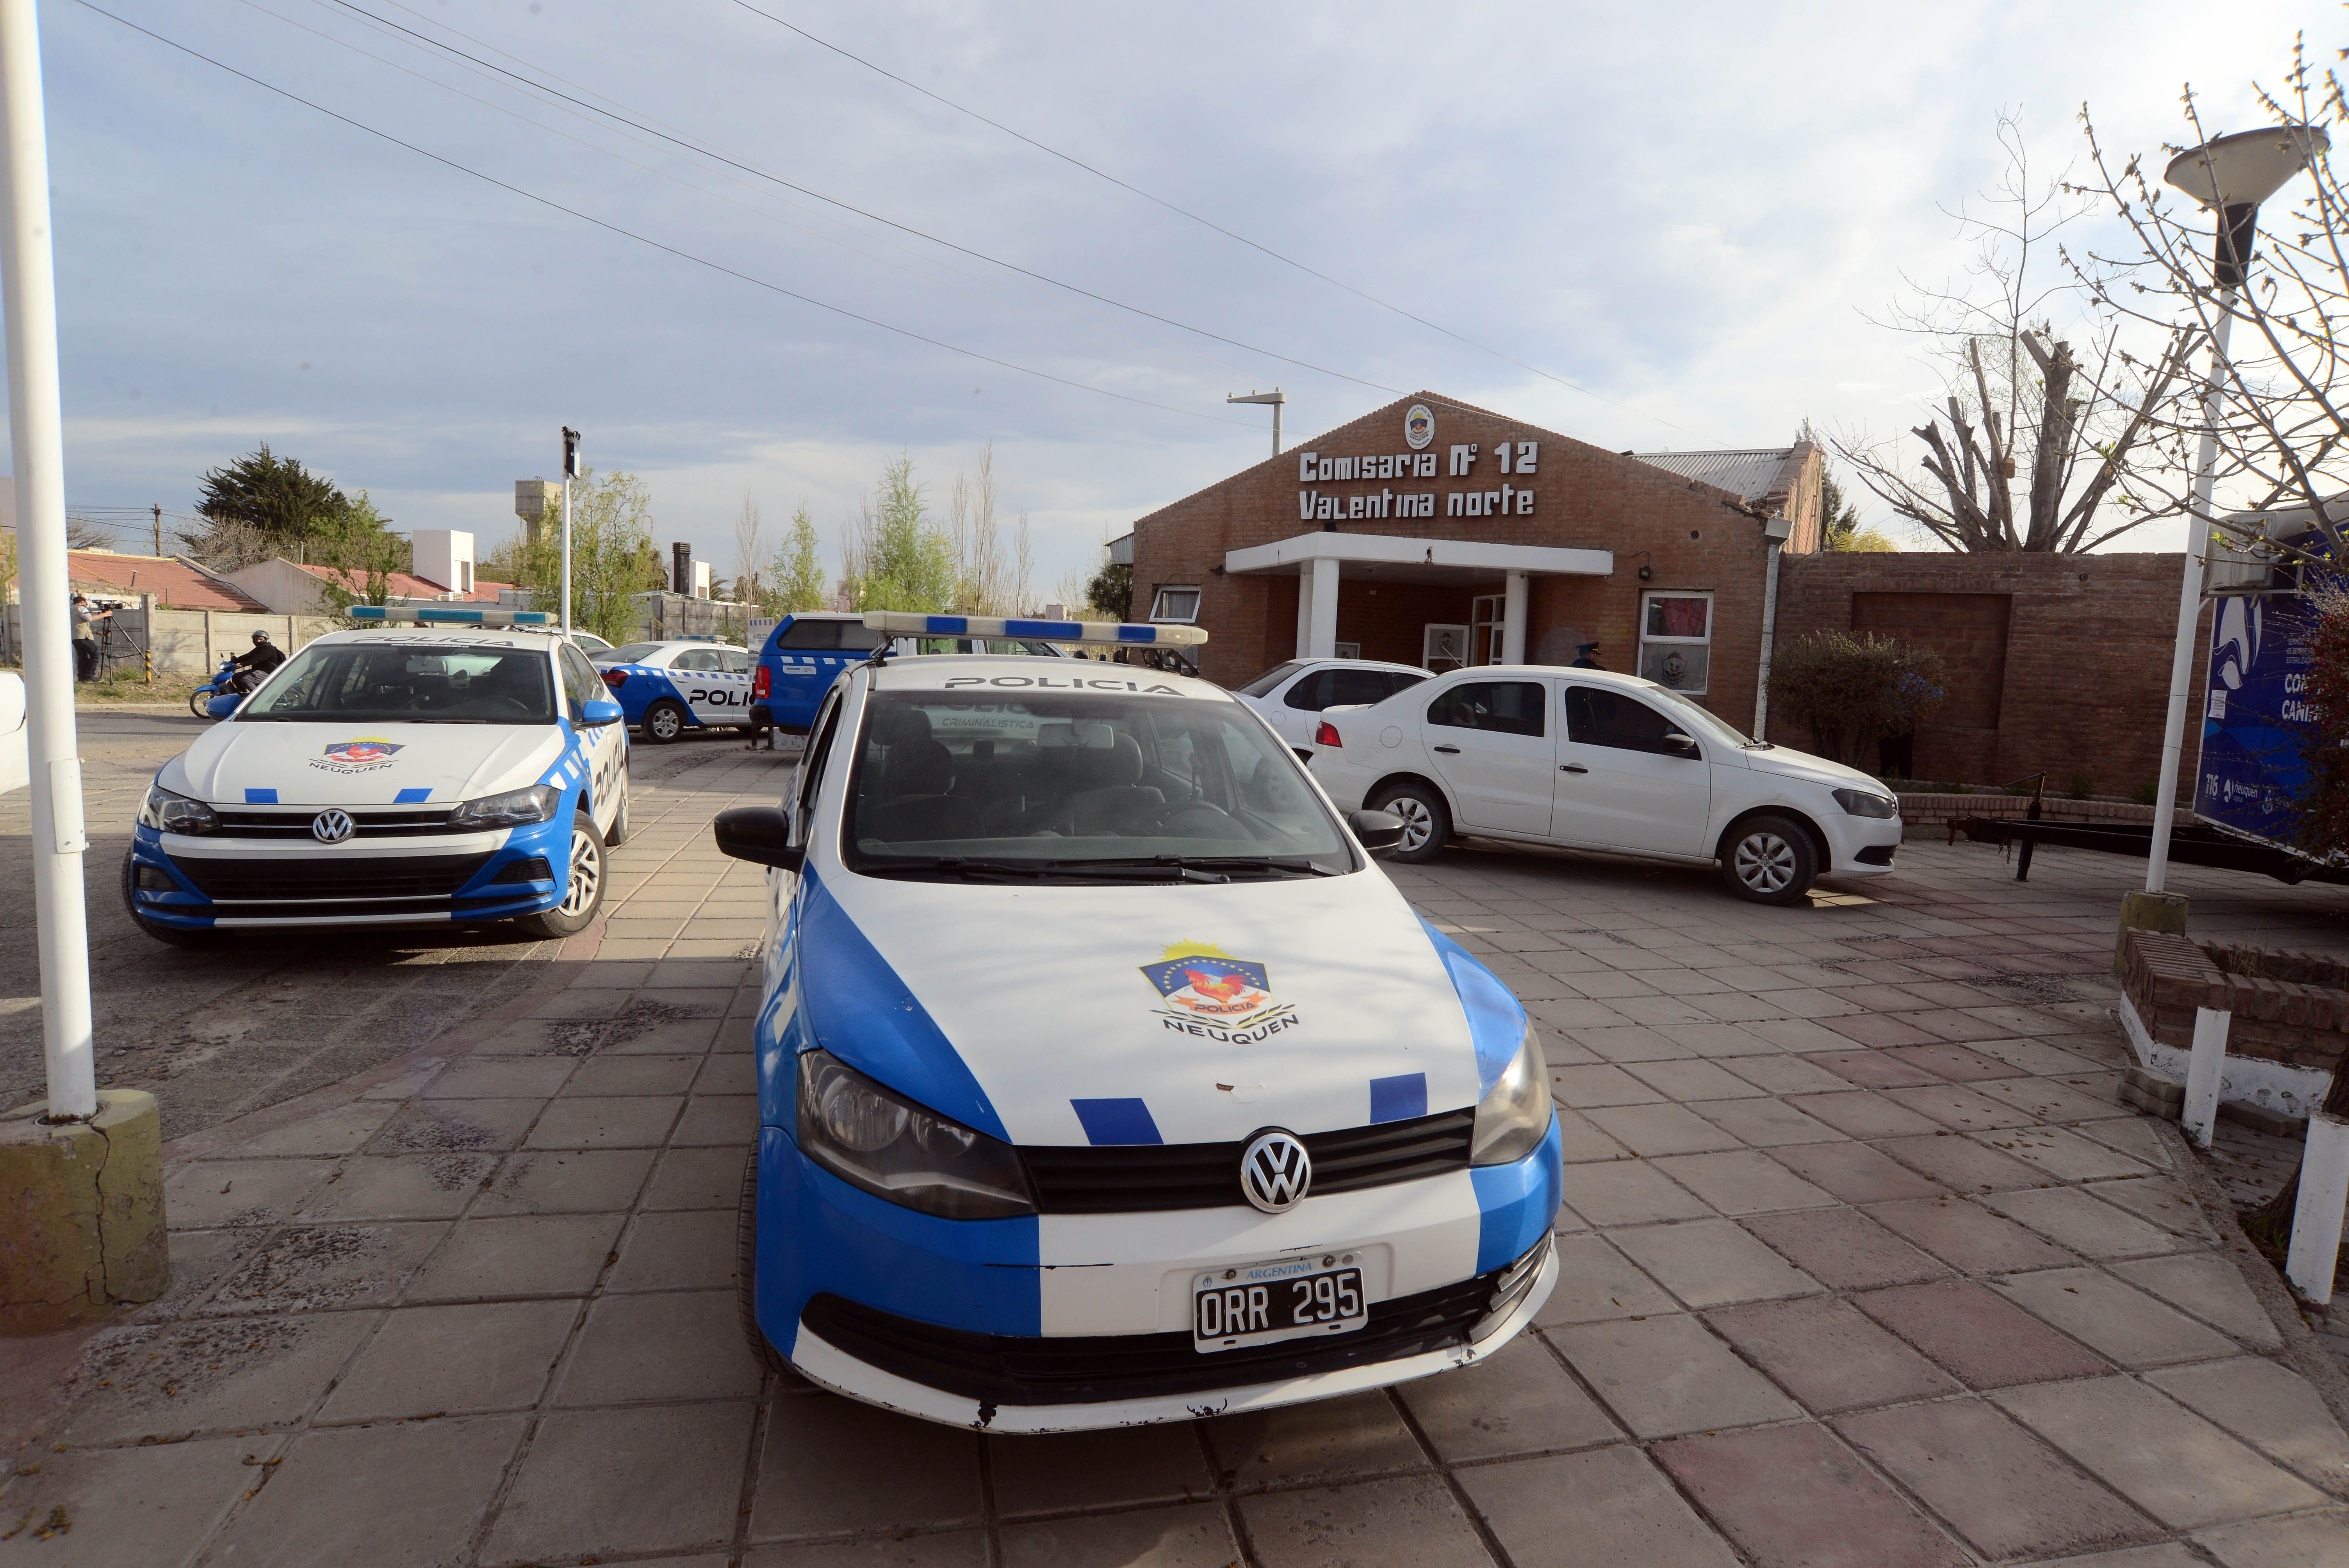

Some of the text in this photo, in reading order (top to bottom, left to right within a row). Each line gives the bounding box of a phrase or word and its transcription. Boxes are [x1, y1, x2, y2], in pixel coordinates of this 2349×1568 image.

[1408, 407, 1427, 422] COMISARIA
[1494, 441, 1538, 474] 12
[1448, 483, 1534, 516] norte
[350, 636, 514, 647] POLICIA
[944, 677, 1186, 697] POLICIA
[942, 718, 1034, 729] CRIMINALISTICA
[309, 763, 392, 774] NEUQUEN
[2206, 773, 2219, 796] 116
[1194, 1002, 1256, 1013] POLICIA
[1163, 1014, 1299, 1045] NEUQUEN
[1246, 1262, 1312, 1279] ARGENTINA
[1201, 1272, 1358, 1336] ORR 295
